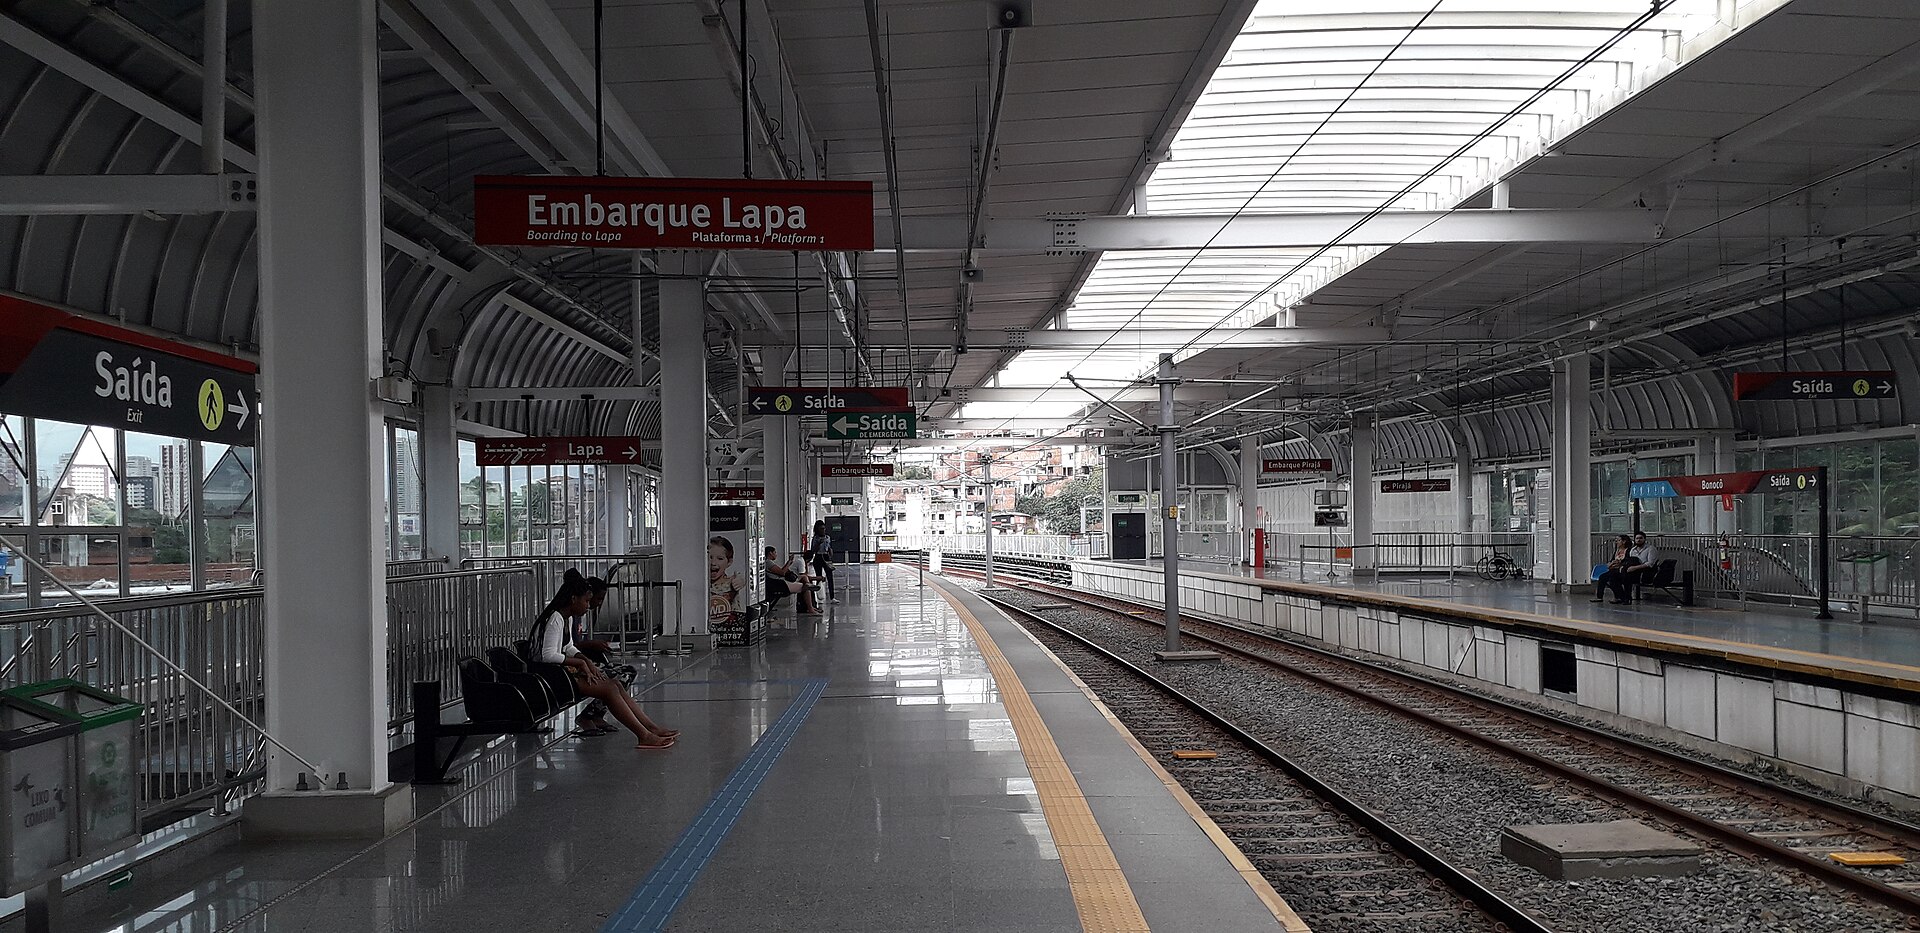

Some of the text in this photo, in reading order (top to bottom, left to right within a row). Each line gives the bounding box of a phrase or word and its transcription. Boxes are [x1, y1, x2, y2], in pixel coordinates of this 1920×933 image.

[528, 193, 807, 237] Embarque Lapa
[527, 229, 622, 244] Boarding to Lapa
[692, 231, 751, 243] Plataforma
[754, 235, 760, 243] 1
[770, 232, 817, 246] Platform
[819, 235, 825, 244] 1
[94, 350, 173, 409] Saída
[1792, 379, 1833, 394] Saída
[804, 394, 845, 409] Saída
[126, 407, 144, 424] Exit
[859, 415, 908, 431] Saída
[870, 431, 909, 439] EMERGÊNCIA
[568, 442, 604, 457] Lapa
[831, 467, 883, 476] Embarque Lapa
[1301, 461, 1321, 470] Pirajá
[1392, 482, 1412, 491] Pirajá
[1701, 479, 1724, 490] Bonocô
[1770, 474, 1790, 487] Saída
[738, 489, 755, 497] Lapa
[31, 790, 50, 807] LIXO
[24, 806, 57, 828] COMUM
